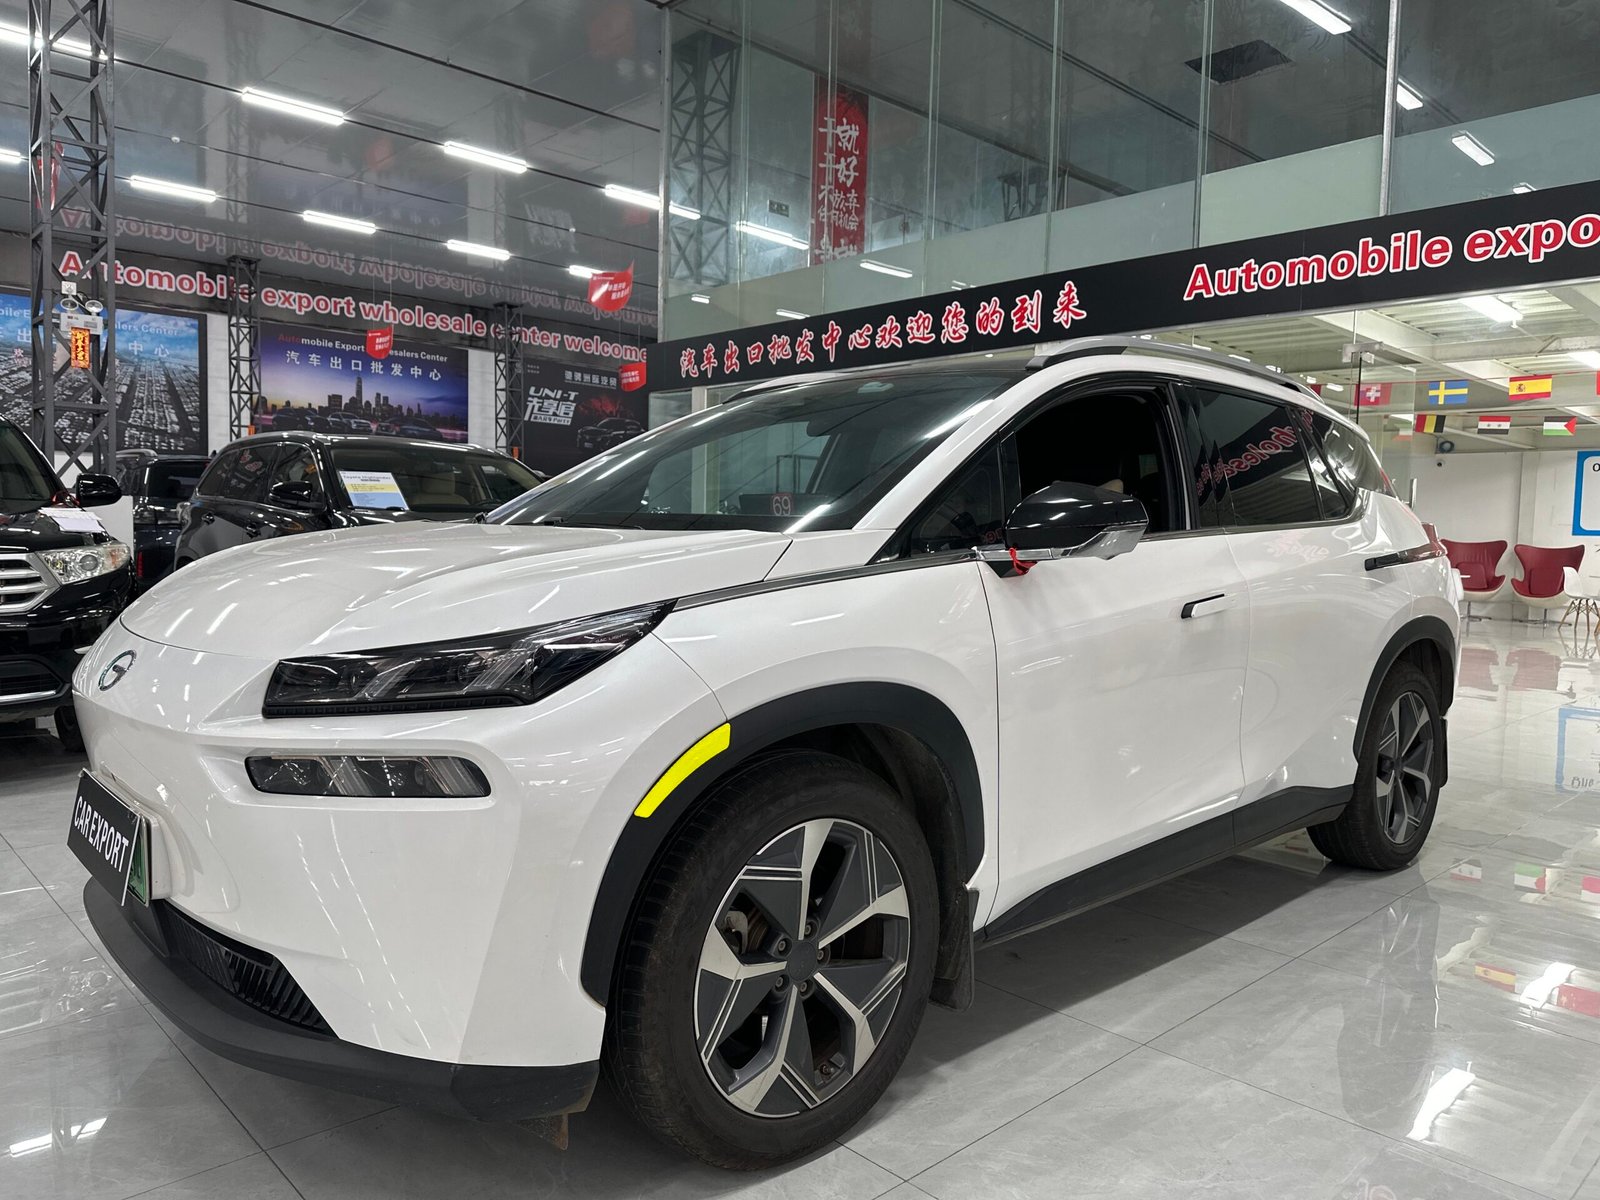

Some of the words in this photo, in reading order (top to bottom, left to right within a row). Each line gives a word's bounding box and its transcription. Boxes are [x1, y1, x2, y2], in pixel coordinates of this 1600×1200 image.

[1183, 229, 1453, 301] Automobile
[1464, 212, 1600, 263] expo
[141, 323, 178, 336] Center
[262, 286, 355, 319] export
[360, 300, 486, 338] wholesale
[563, 333, 647, 363] welcome
[680, 280, 1087, 379] 汽车出口批发中心欢迎您的到来
[278, 333, 333, 349] Automobile
[335, 340, 365, 353] Export
[388, 348, 419, 359] esalers
[420, 351, 448, 363] Center
[286, 350, 442, 381] 汽车出口批发中心
[529, 386, 579, 401] UNI-T
[772, 496, 791, 516] 69
[74, 795, 92, 840] CAR
[88, 810, 130, 873] EXPORT
